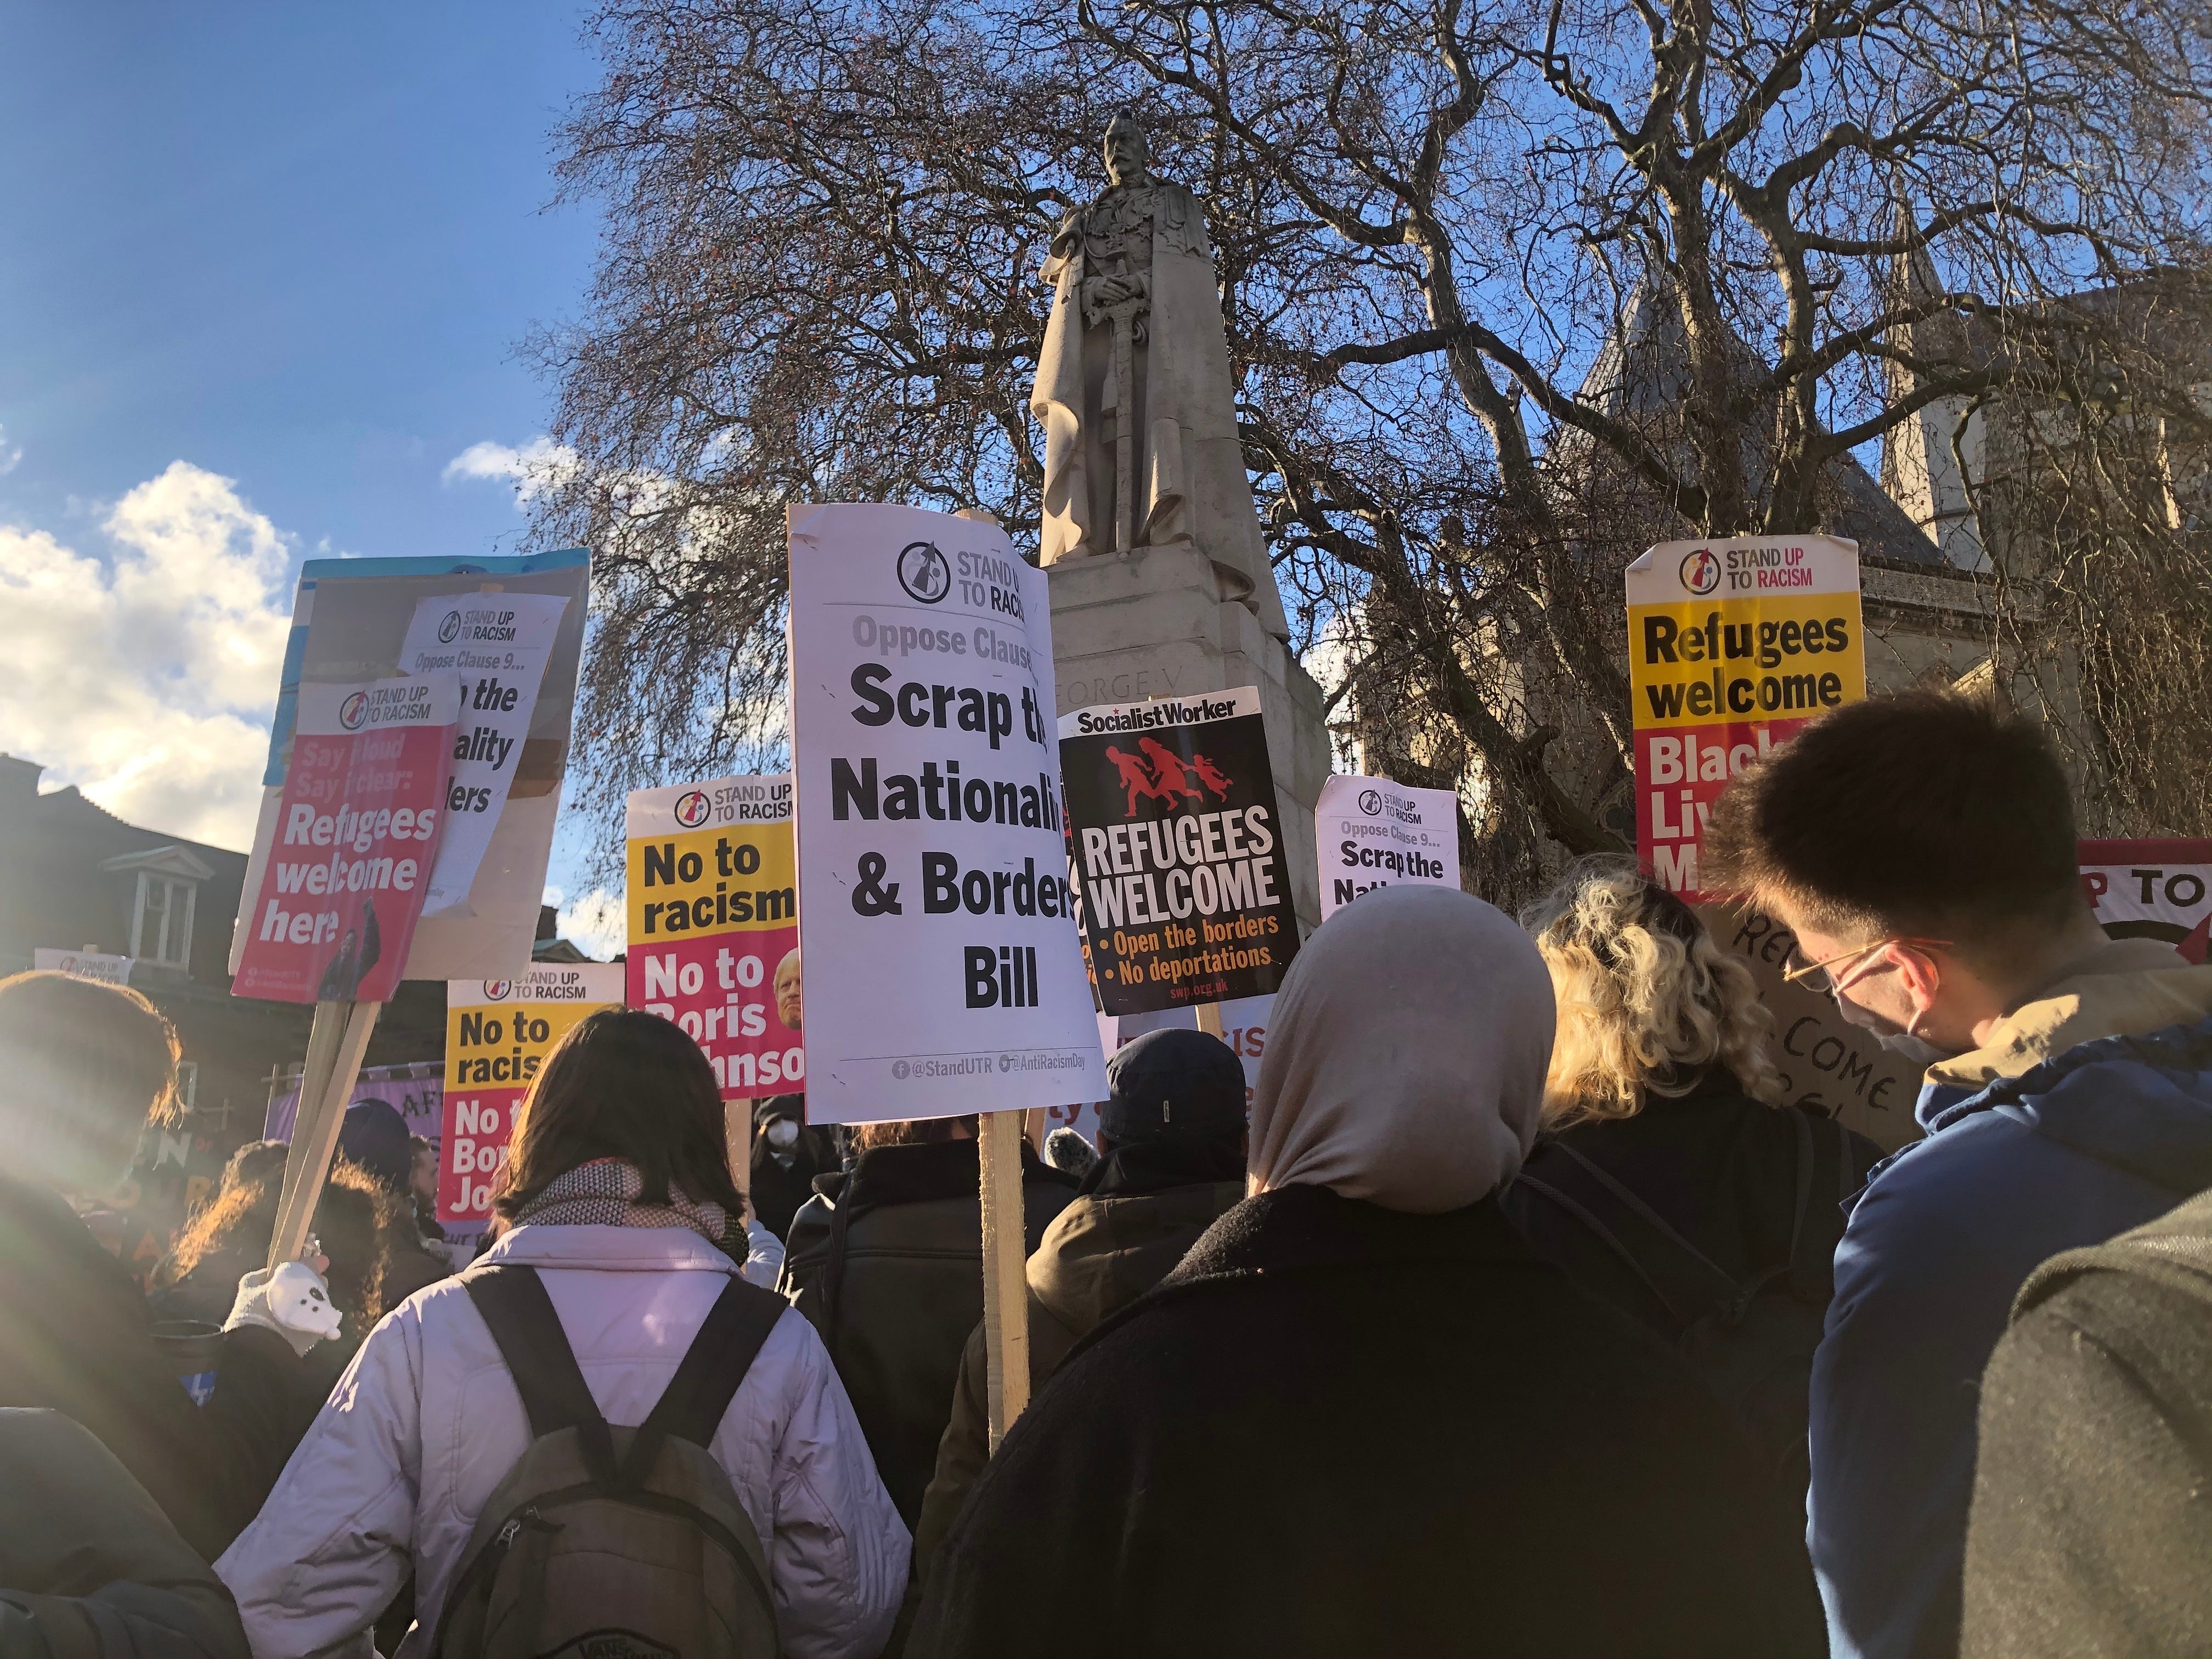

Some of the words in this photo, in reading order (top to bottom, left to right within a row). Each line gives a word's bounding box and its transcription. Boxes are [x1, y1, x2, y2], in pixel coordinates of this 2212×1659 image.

[957, 550, 1012, 587] STAND
[1727, 548, 1781, 569] STAND
[1785, 548, 1804, 566] UP
[958, 579, 986, 607] TO
[1728, 569, 1752, 590] TO
[1758, 567, 1813, 588] RACISM
[461, 627, 472, 641] TO
[472, 626, 517, 641] RACISM
[464, 610, 496, 625] STAND
[498, 611, 515, 625] UP
[853, 615, 967, 657] Oppose
[1644, 611, 1849, 669] Refugees
[415, 652, 455, 673] Oppose
[456, 651, 500, 669] Clause
[371, 687, 407, 706] STAND
[409, 686, 429, 702] UP
[850, 663, 1013, 751] Scrap
[1646, 667, 1842, 719] welcome
[382, 703, 432, 723] RACISM
[302, 741, 346, 772] Say
[295, 771, 340, 804] Say
[715, 785, 765, 805] STAND
[771, 783, 792, 801] UP
[1384, 793, 1403, 809] STAND
[1404, 801, 1416, 812] UP
[284, 803, 437, 853] Refugees
[715, 804, 735, 823] TO
[1385, 805, 1395, 817] TO
[1396, 808, 1422, 825] RACISM
[1081, 805, 1273, 877] REFUGEES
[1341, 821, 1389, 838] Oppose
[1391, 825, 1418, 845] Clause
[276, 852, 417, 895] welcome
[644, 843, 703, 888] No
[715, 837, 761, 877] to
[1341, 840, 1404, 878] Scrap
[1406, 851, 1443, 879] the
[852, 852, 902, 917] &
[1087, 855, 1280, 929] WELCOME
[2131, 868, 2205, 907] TO
[644, 882, 795, 934] racism
[1114, 930, 1160, 960] Open
[1165, 923, 1197, 949] the
[1202, 913, 1279, 944] borders
[561, 972, 580, 985] UP
[645, 953, 704, 1000] No
[716, 948, 764, 990] to
[964, 946, 1039, 1009] Bill
[1119, 960, 1144, 985] No
[1149, 945, 1272, 984] deportations
[514, 986, 532, 998] TO
[535, 986, 586, 999] RACISM
[1170, 978, 1229, 1001] swp.org.uk
[460, 1013, 503, 1047] No
[512, 1011, 550, 1044] to
[912, 1057, 993, 1078] @StandUTR
[1013, 1051, 1085, 1071] @AntiRacismDay
[455, 1099, 499, 1136] No
